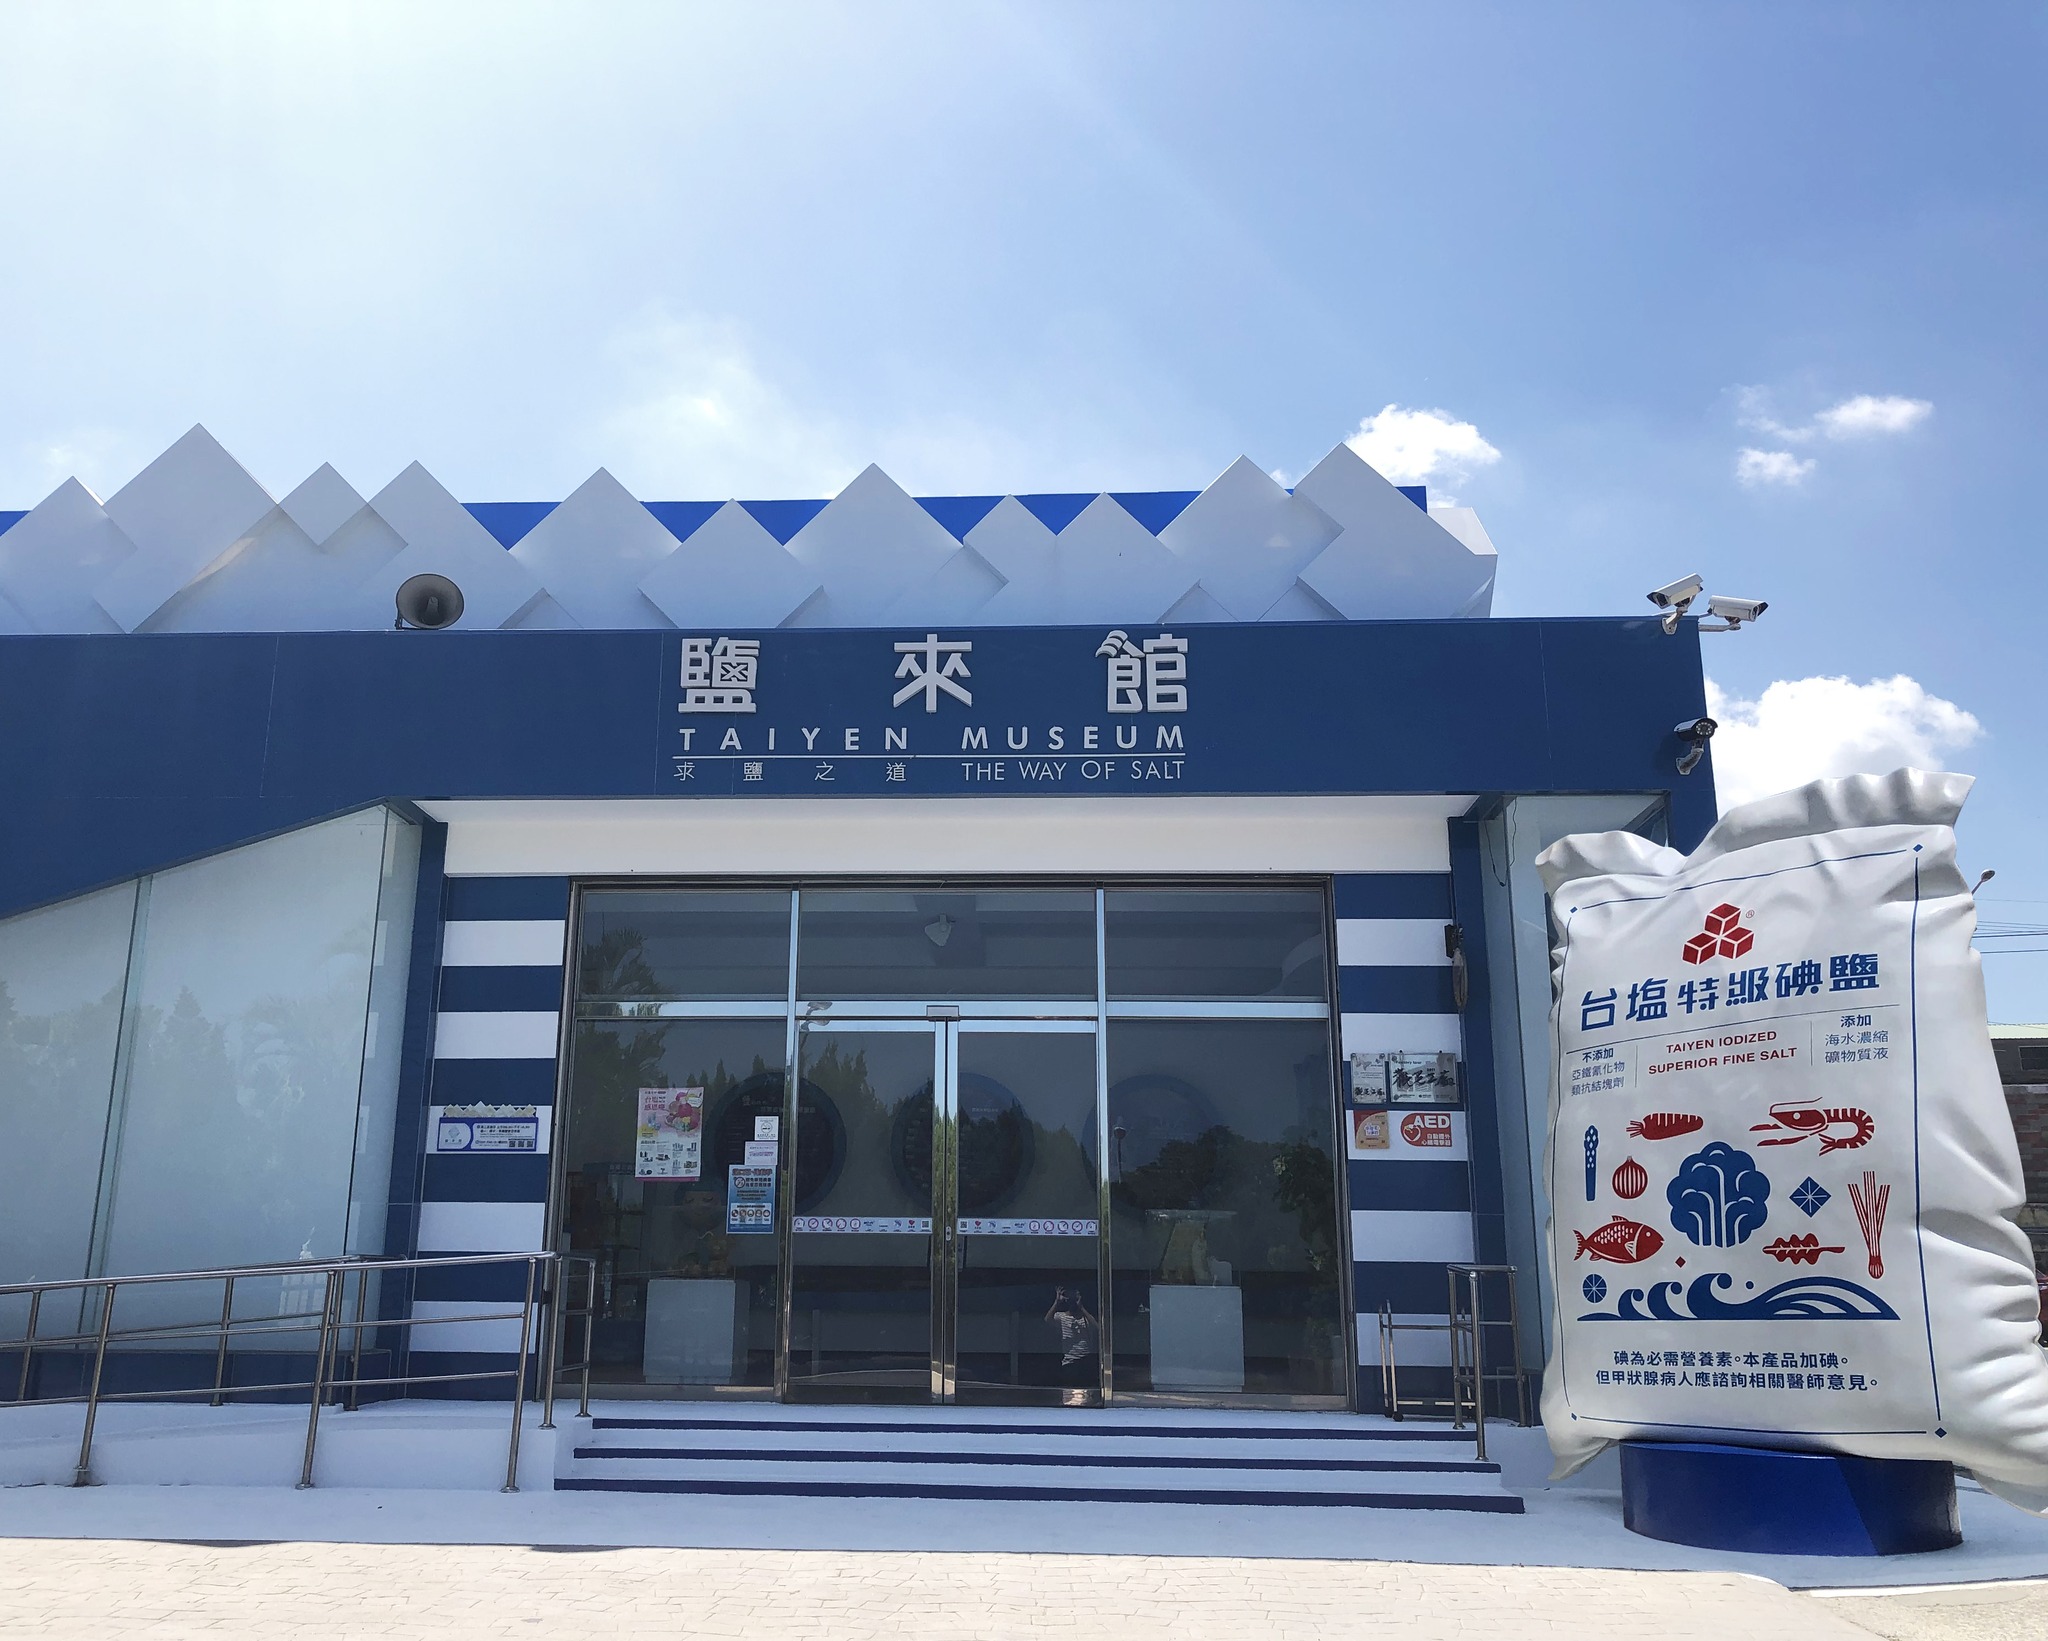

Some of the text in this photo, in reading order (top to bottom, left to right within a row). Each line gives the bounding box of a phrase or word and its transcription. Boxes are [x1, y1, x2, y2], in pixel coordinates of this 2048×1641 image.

[678, 630, 1188, 713] 鹽來館
[679, 725, 1184, 751] TAIYEN MUSEUM
[673, 761, 907, 782] 求鹽之道
[961, 760, 1185, 781] THE WAY OF SALT
[1580, 953, 1880, 1032] 台塩特級碘鹽
[1840, 1014, 1872, 1028] 添加
[1666, 1030, 1777, 1054] TAIYEN IODIZED
[1825, 1030, 1889, 1047] 海水濃縮
[1582, 1048, 1614, 1063] 不添加
[1648, 1047, 1798, 1075] SUPERIOR FINE SALT
[1825, 1047, 1889, 1063] 礦物質液
[1413, 1115, 1450, 1129] AED
